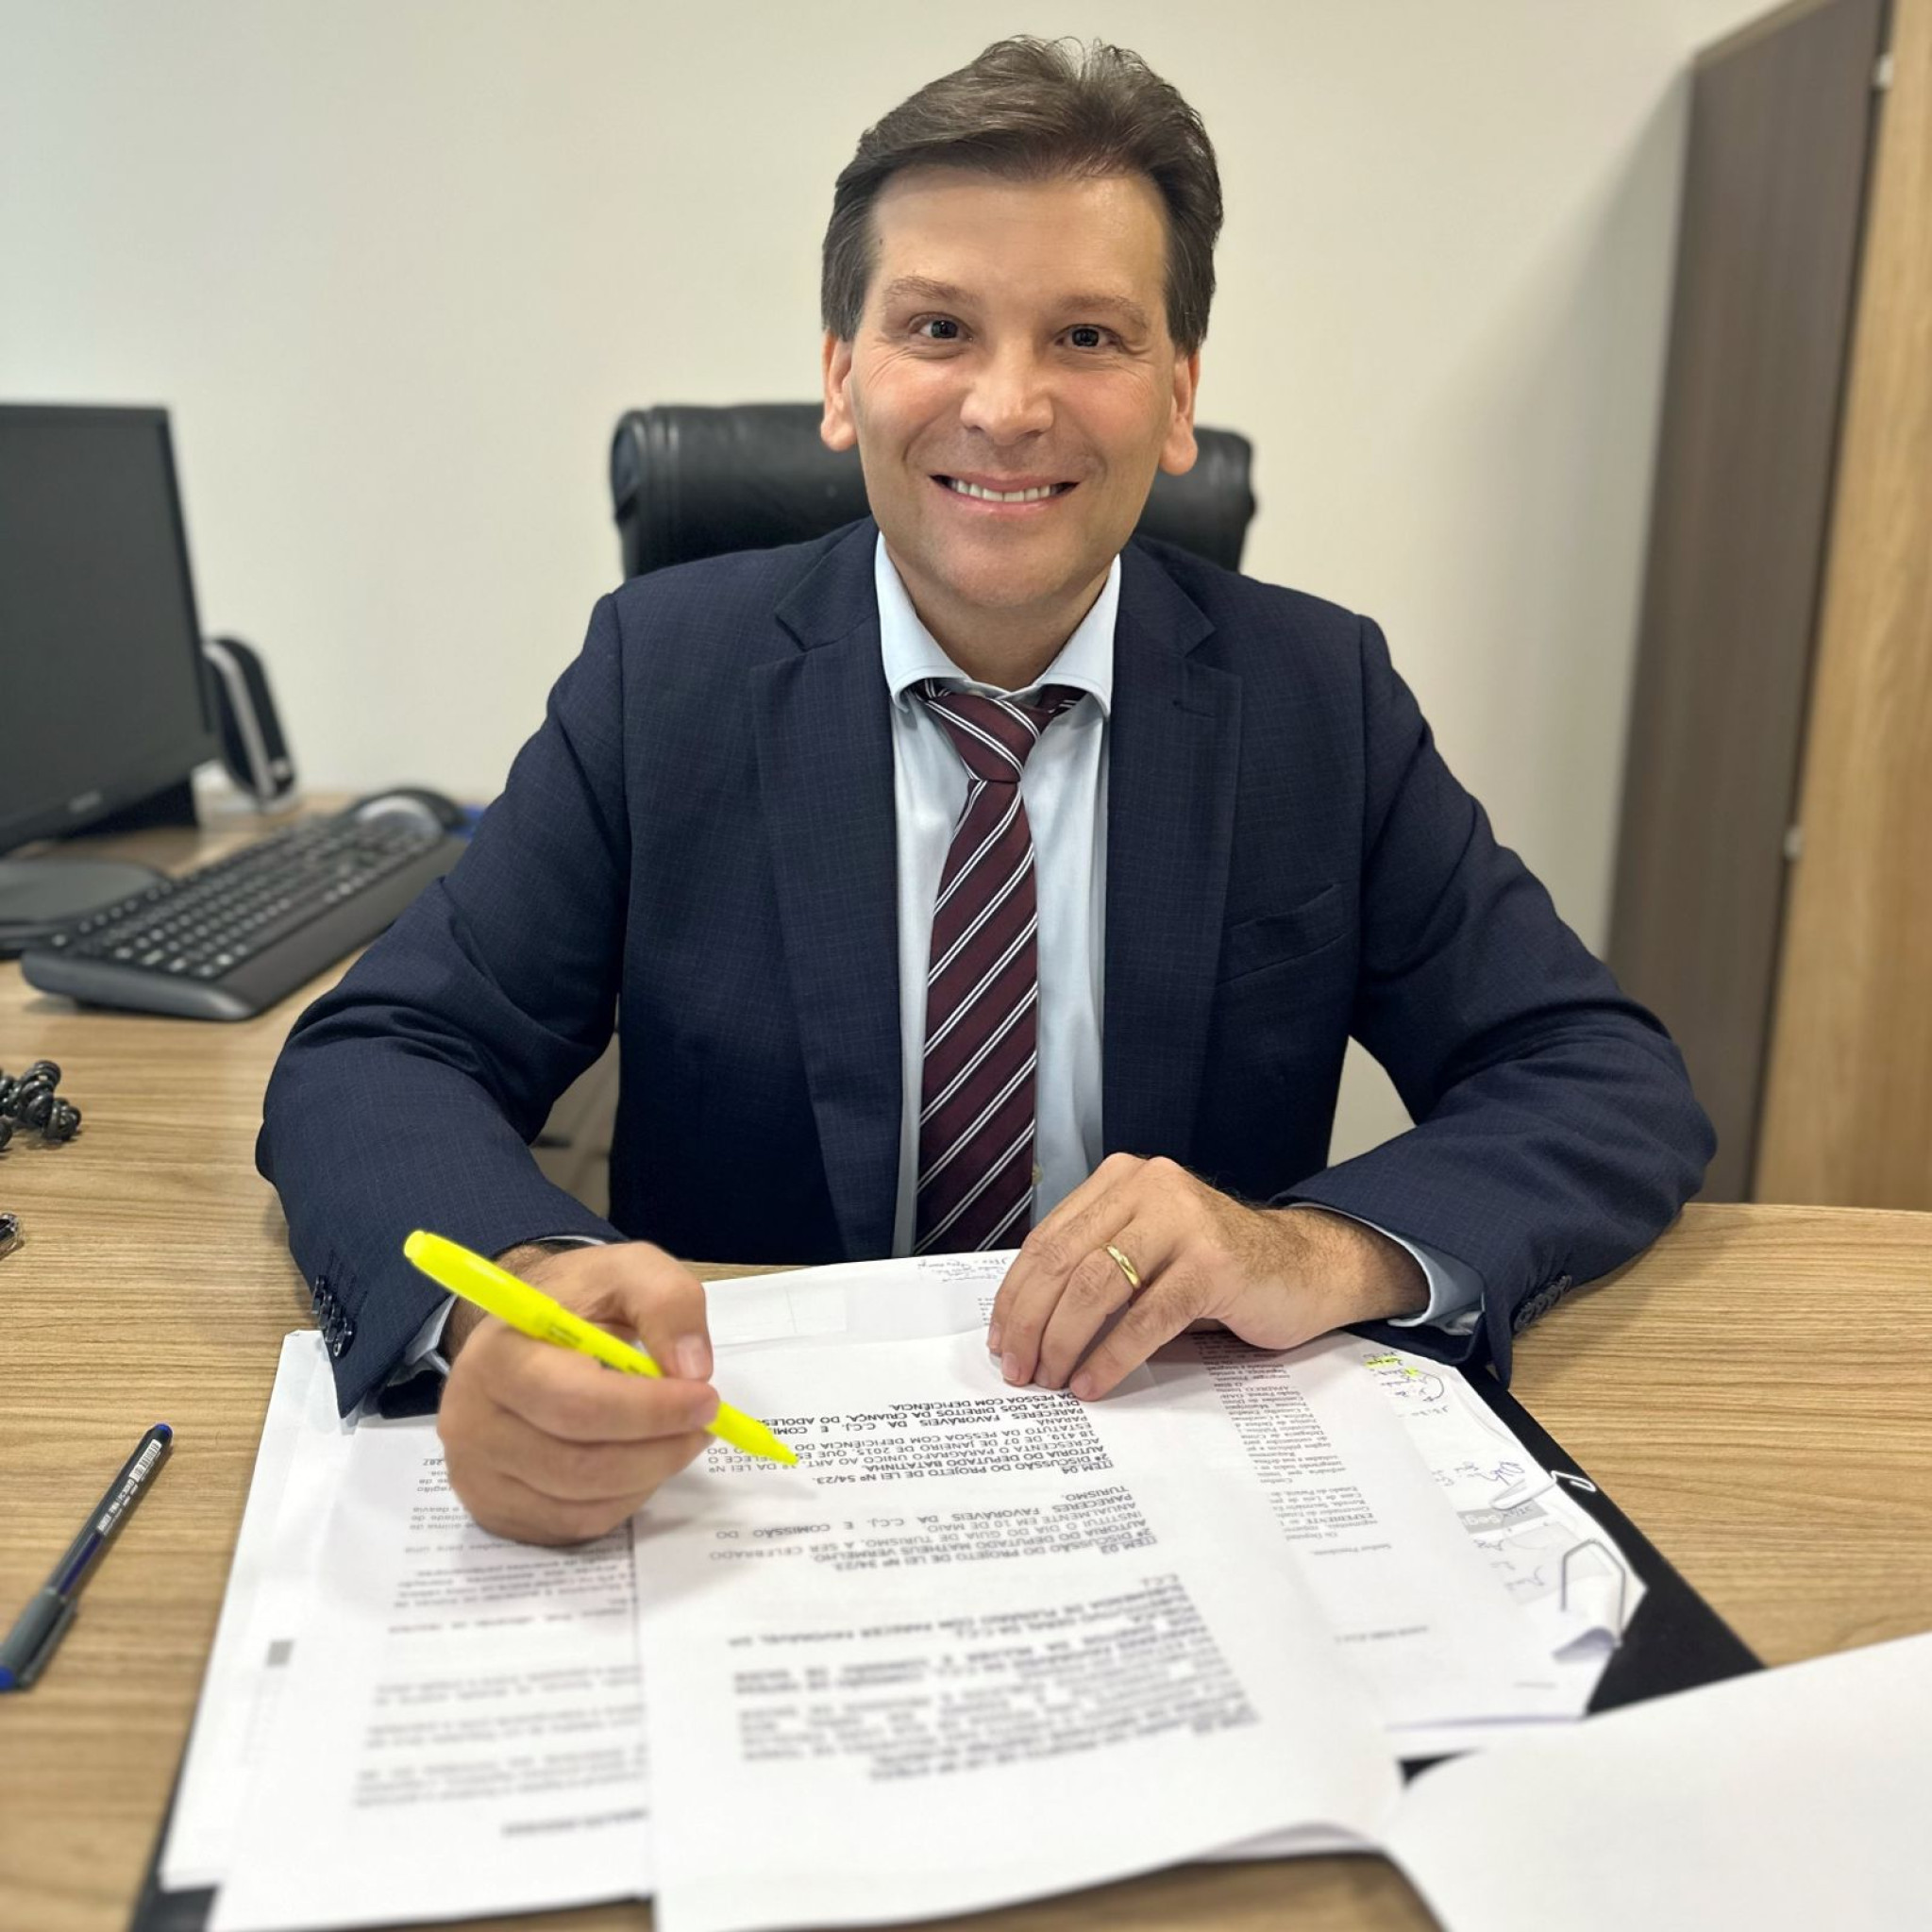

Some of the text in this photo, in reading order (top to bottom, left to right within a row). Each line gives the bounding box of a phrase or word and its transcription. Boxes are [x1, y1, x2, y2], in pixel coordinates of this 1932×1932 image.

[973, 1397, 1004, 1406] COM
[1005, 1394, 1054, 1404] PESSOA
[1031, 1399, 1081, 1410] DEFESA
[887, 1400, 972, 1411] DEFICIÊNCIA.
[999, 1403, 1029, 1414] DOS
[911, 1410, 932, 1419] DA
[935, 1406, 996, 1418] DIREITOS
[1010, 1407, 1084, 1420] PARECERES
[819, 1415, 841, 1424] DO
[887, 1420, 908, 1429] DA
[918, 1414, 1001, 1427] FAVORÁVEIS
[819, 1425, 830, 1434] E
[1000, 1428, 1021, 1437] DA
[1024, 1420, 1092, 1436] ESTATUTO
[909, 1434, 941, 1445] COM
[944, 1430, 998, 1443] PESSOA
[1003, 1436, 1020, 1447] 07
[1023, 1435, 1043, 1444] DE
[794, 1442, 815, 1452] DO
[818, 1436, 906, 1450] DEFICIÊNCIA
[919, 1439, 974, 1453] JANEIRO
[978, 1438, 999, 1448] DE
[1013, 1437, 1100, 1453] ACRESCENTA
[706, 1446, 729, 1455] DO
[817, 1449, 847, 1458] QUE
[895, 1445, 915, 1454] DE
[707, 1455, 719, 1465] O
[801, 1458, 833, 1469] ART.
[837, 1456, 858, 1466] AO
[861, 1445, 1103, 1472] AUTORIA DO DEPUTADO BATATINHA.
[1015, 1455, 1091, 1471] DISCUSSÃO
[731, 1464, 752, 1473] LEI
[756, 1462, 777, 1471] DA
[927, 1466, 987, 1477] PROJETO
[990, 1464, 1012, 1473] DO
[1061, 1459, 1114, 1475] ITEM 04
[811, 1473, 856, 1485] 54/23.
[880, 1472, 900, 1482] LEI
[904, 1470, 924, 1479] DE
[1059, 1486, 1130, 1502] TURISMO.
[1050, 1493, 1134, 1513] PARECERES
[950, 1507, 1040, 1522] FAVORÁVEIS
[1041, 1502, 1136, 1524] ANUALMENTE
[1082, 1510, 1142, 1527] INSTITUI
[916, 1514, 939, 1524] DA
[993, 1520, 1012, 1529] 10
[1016, 1517, 1038, 1527] EM
[1306, 1513, 1374, 1525] EXPEDIENTE
[843, 1520, 854, 1531] E
[969, 1520, 990, 1530] DE
[1033, 1524, 1061, 1535] DIA
[1065, 1521, 1078, 1531] O
[1083, 1519, 1146, 1537] AUTORIA
[714, 1530, 740, 1540] DO
[752, 1524, 832, 1538] COMISSÃO
[964, 1530, 1001, 1541] GUIA
[1007, 1528, 1030, 1537] DO
[1057, 1531, 1082, 1541] DO
[939, 1533, 960, 1543] DE
[975, 1535, 1055, 1549] DEPUTADO
[1050, 1532, 1133, 1554] DISCUSSÃO
[809, 1542, 839, 1554] SER
[843, 1540, 855, 1550] A
[899, 1542, 971, 1555] MATHEUS
[708, 1546, 802, 1561] CELEBRADO
[955, 1549, 1020, 1561] PROJETO
[1023, 1546, 1047, 1556] DO
[903, 1555, 927, 1566] LEI
[931, 1554, 952, 1563] DE
